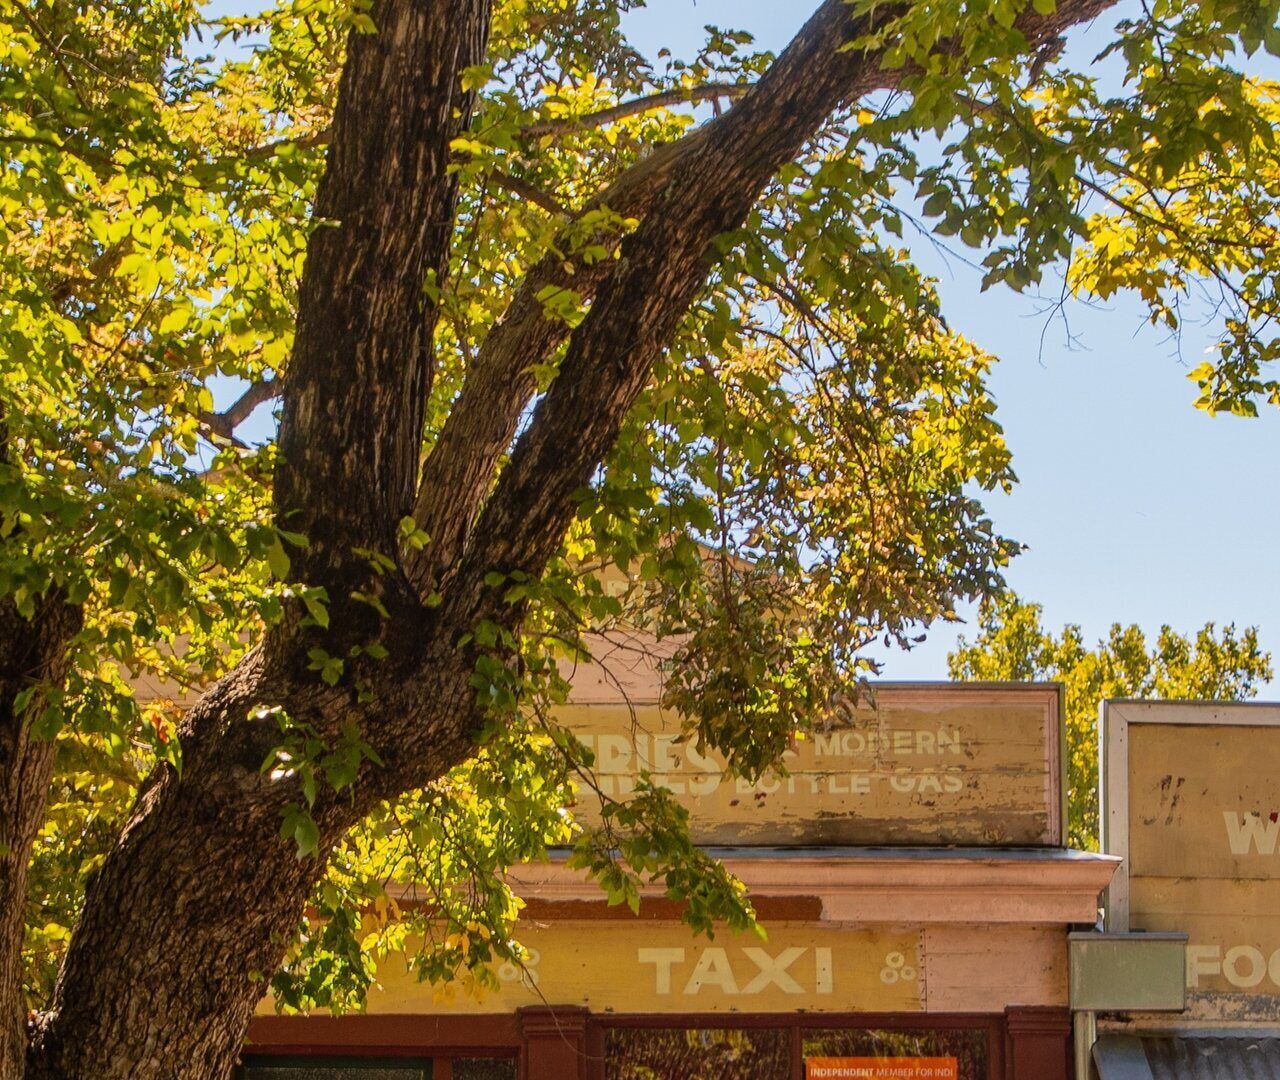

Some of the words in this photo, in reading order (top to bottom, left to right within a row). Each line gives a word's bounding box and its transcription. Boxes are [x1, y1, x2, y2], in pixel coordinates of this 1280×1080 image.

[814, 730, 961, 756] MODERN
[889, 767, 964, 793] GAS
[637, 946, 834, 994] TAXI
[810, 1067, 873, 1078] INDEPENDENT
[876, 1067, 914, 1078] MEMBER
[916, 1067, 933, 1078] FOR
[935, 1067, 954, 1078] INDI
